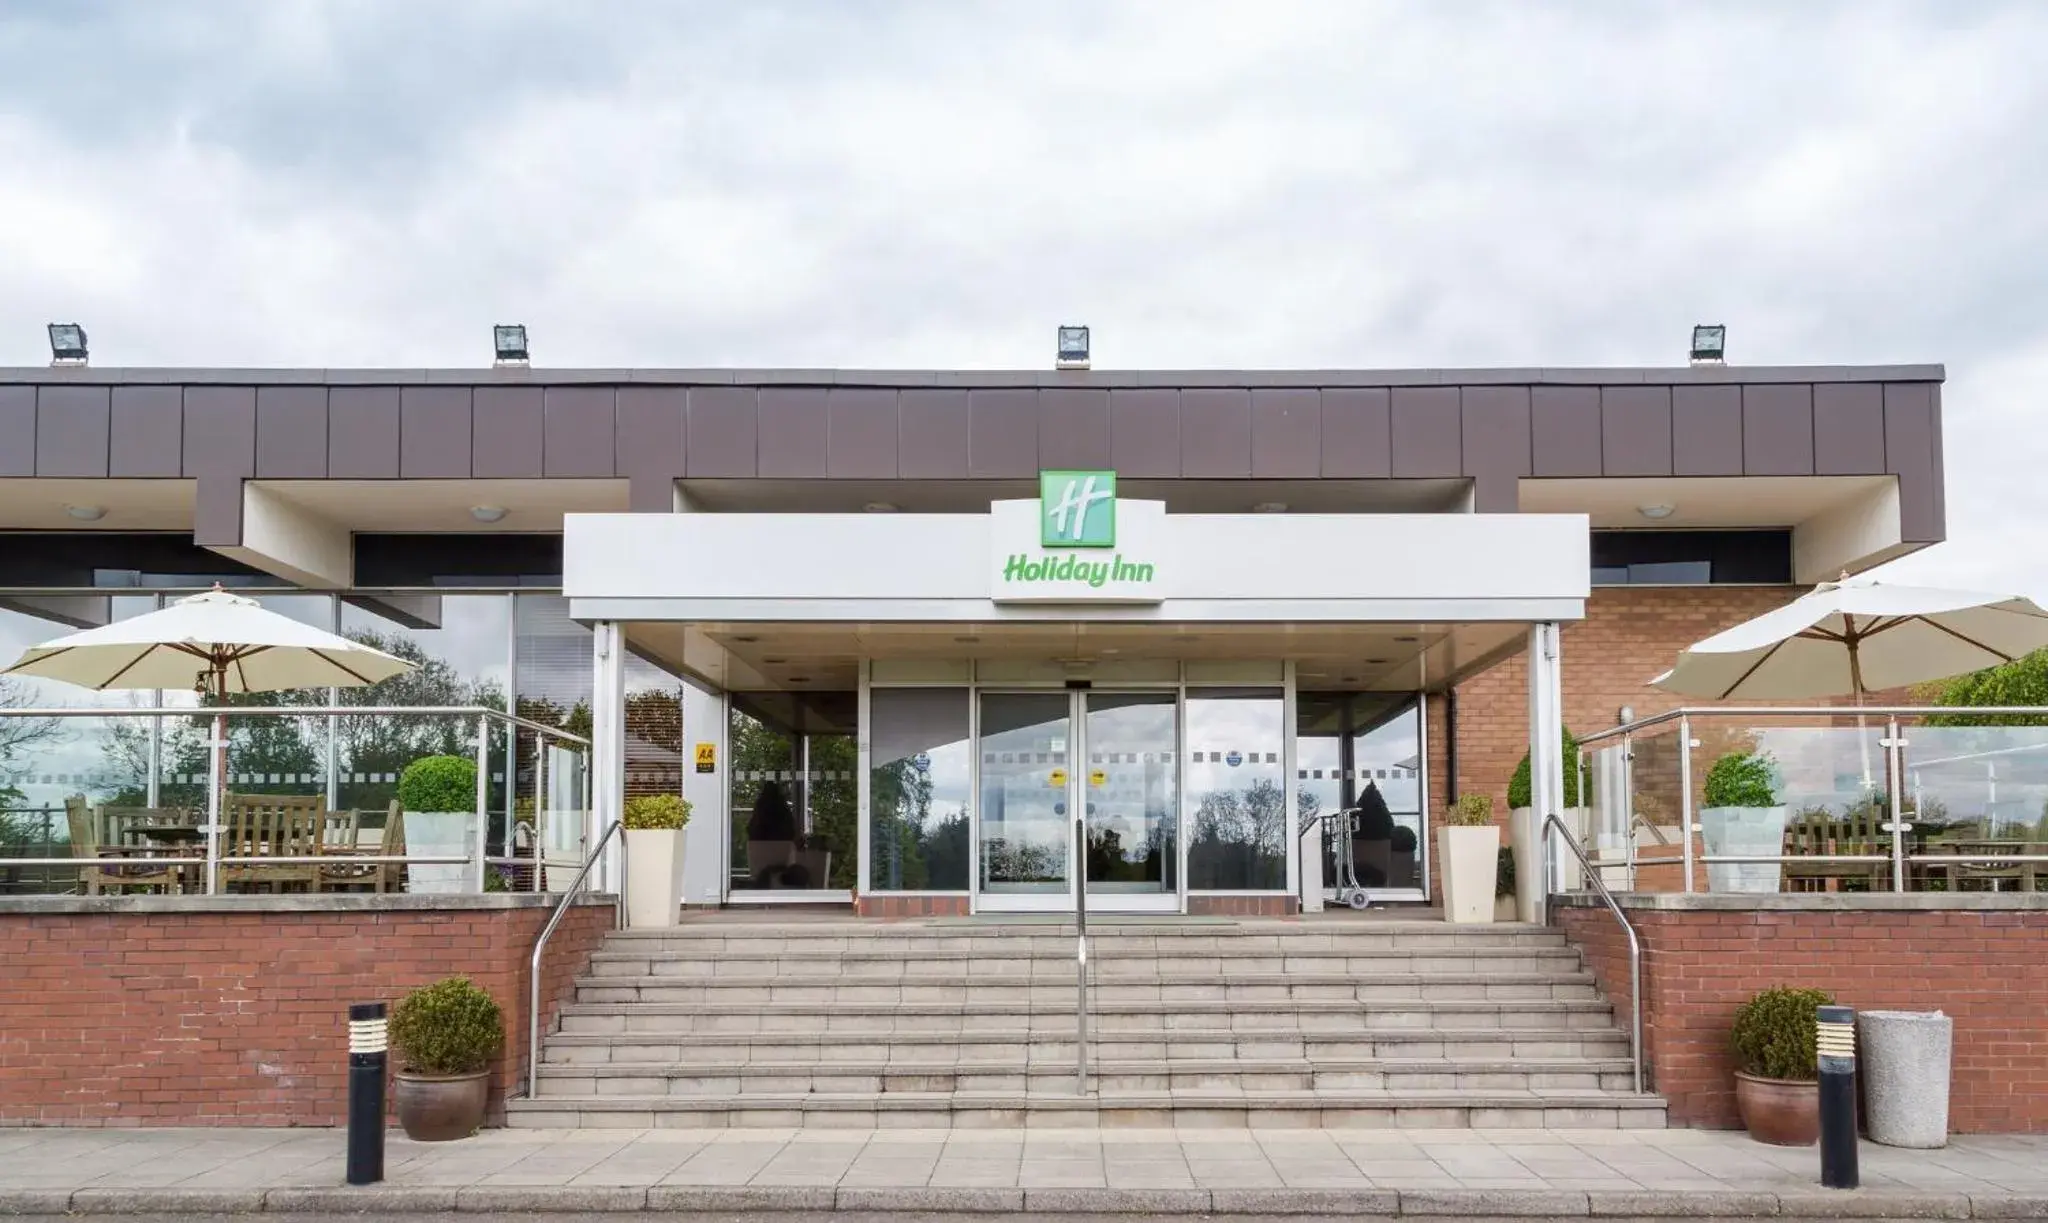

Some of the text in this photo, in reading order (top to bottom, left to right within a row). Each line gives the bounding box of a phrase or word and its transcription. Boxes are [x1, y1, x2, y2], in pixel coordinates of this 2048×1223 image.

[1049, 476, 1112, 540] H
[1003, 554, 1154, 587] Holiday Inn
[698, 748, 714, 760] AA
